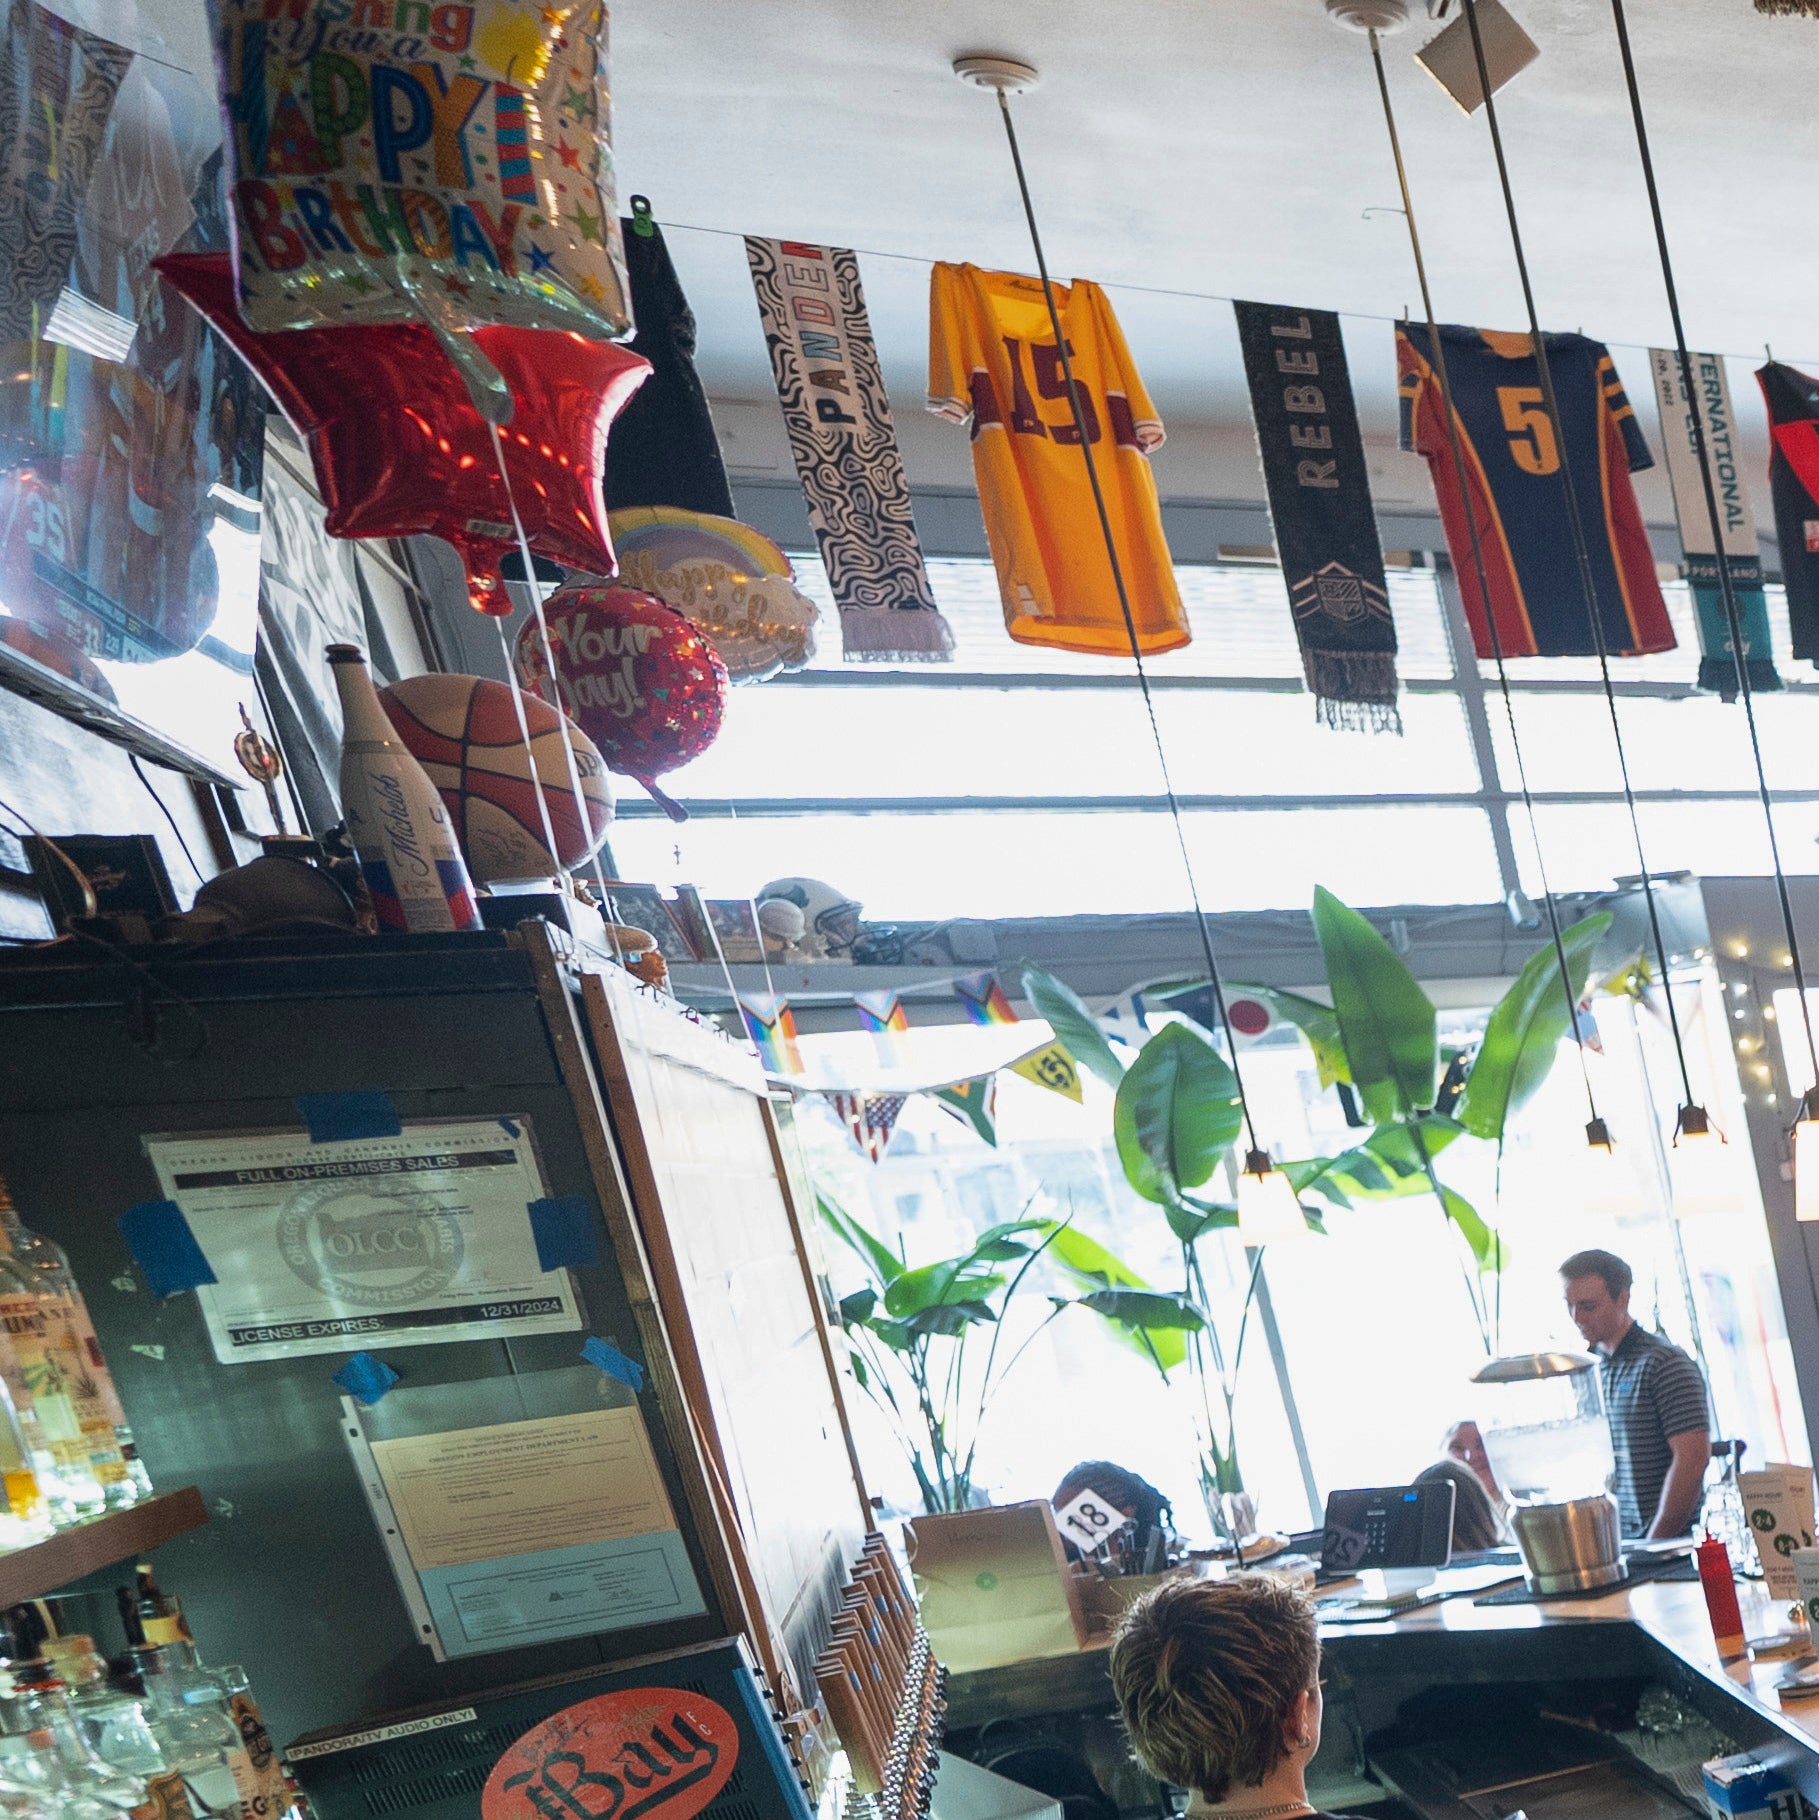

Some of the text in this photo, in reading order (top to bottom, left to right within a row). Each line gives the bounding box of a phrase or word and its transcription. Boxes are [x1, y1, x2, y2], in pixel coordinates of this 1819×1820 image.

[236, 180, 524, 278] BIRTHDAY
[1002, 337, 1101, 446] 15
[1273, 315, 1340, 489] REBEL
[1496, 385, 1561, 476] 5
[554, 612, 664, 667] Your
[236, 1154, 460, 1183] FULL ON-PREMISES SALES
[326, 1226, 424, 1258] OLCC
[319, 1268, 450, 1303] COMMISSION
[231, 1299, 561, 1346] LICENSE EXPIRES: 12/31/2024
[1066, 1503, 1109, 1538] 18
[386, 1720, 432, 1739] AUDIO
[432, 1709, 476, 1728] ONLY!
